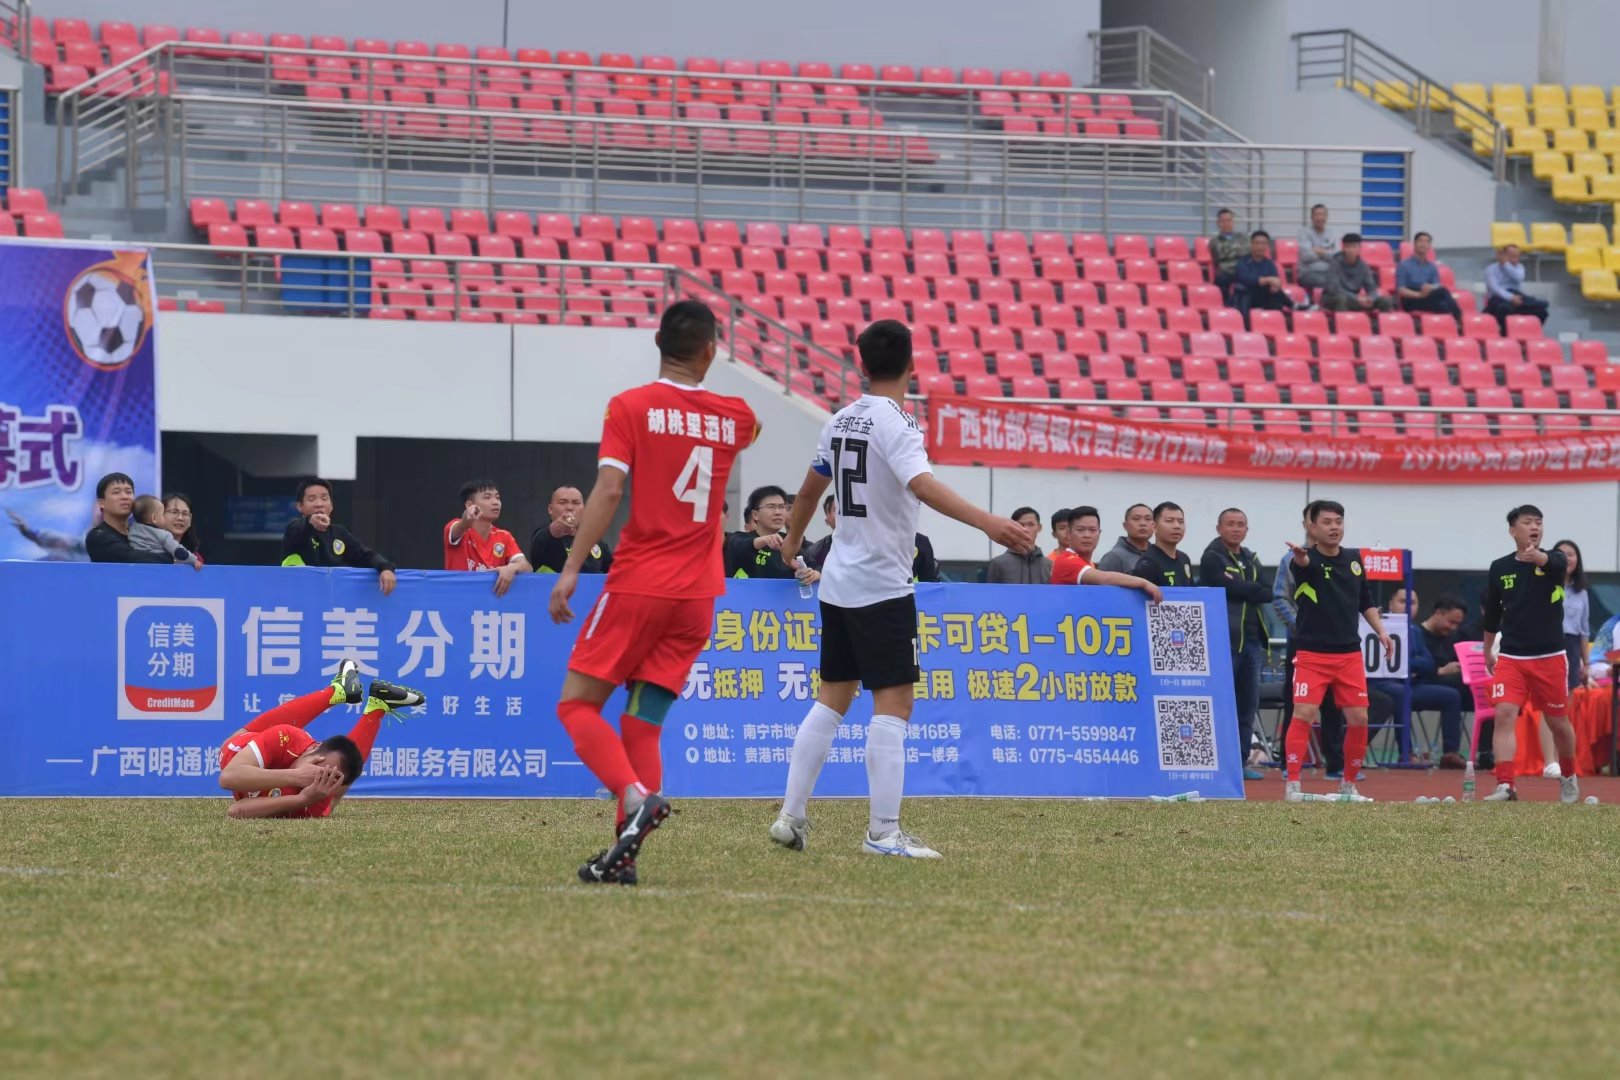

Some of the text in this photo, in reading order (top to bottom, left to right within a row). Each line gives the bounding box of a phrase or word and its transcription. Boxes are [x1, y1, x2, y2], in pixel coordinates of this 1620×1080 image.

[646, 407, 737, 445] 胡桃里酒馆
[833, 415, 874, 436] 华邦五金
[671, 445, 714, 523] 4
[830, 436, 868, 518] 12
[1503, 578, 1514, 589] 13
[147, 622, 195, 648] 信美
[242, 606, 526, 680] 信美分期
[147, 652, 195, 678] 分期
[682, 661, 765, 700] 无抵押
[967, 662, 1139, 702] 极速2小时放款
[1294, 682, 1309, 697] 18
[1491, 683, 1505, 698] 13
[147, 697, 195, 708] CreditMate
